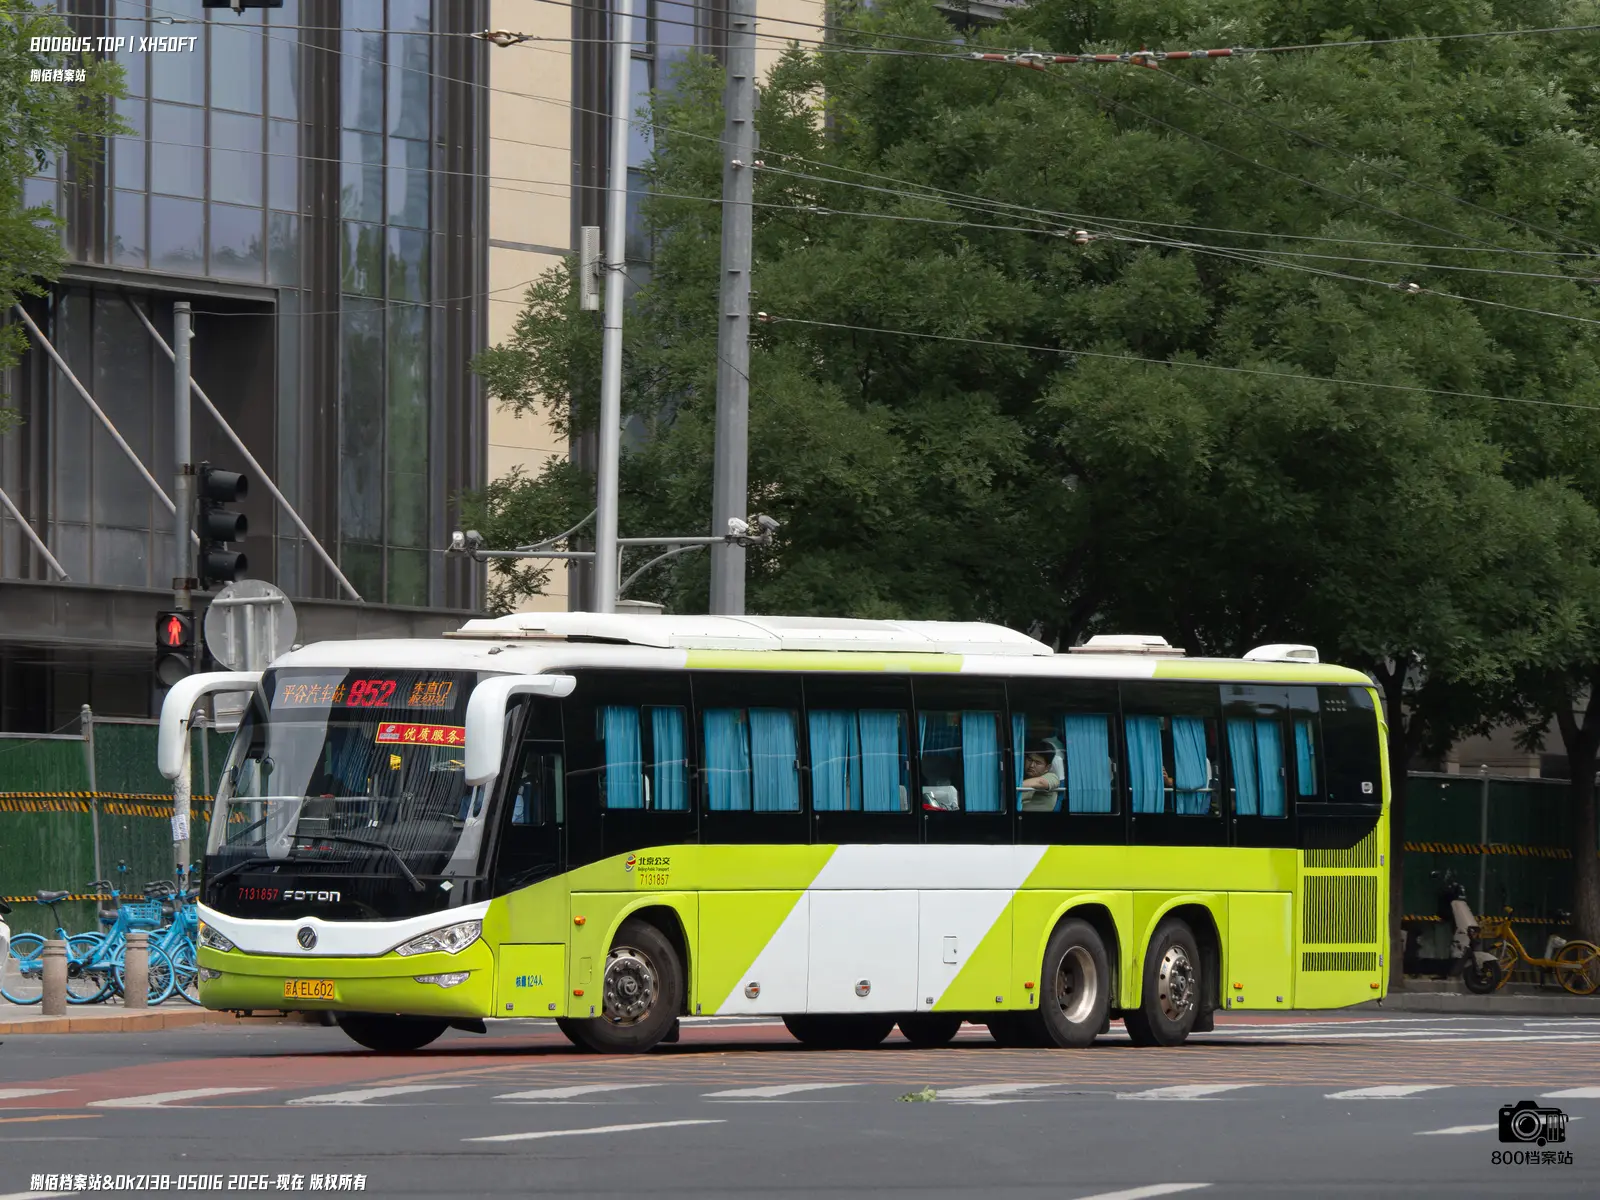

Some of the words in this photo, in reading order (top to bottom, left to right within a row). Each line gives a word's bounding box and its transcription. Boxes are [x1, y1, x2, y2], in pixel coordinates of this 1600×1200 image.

[283, 683, 346, 704] 平谷汽车站
[346, 679, 397, 707] 852
[412, 681, 453, 695] 东直门
[403, 727, 466, 744] 优质服务
[638, 856, 671, 866] 北京公交
[640, 873, 669, 886] 7131857
[238, 887, 279, 901] 7131857
[283, 890, 341, 902] FOTON
